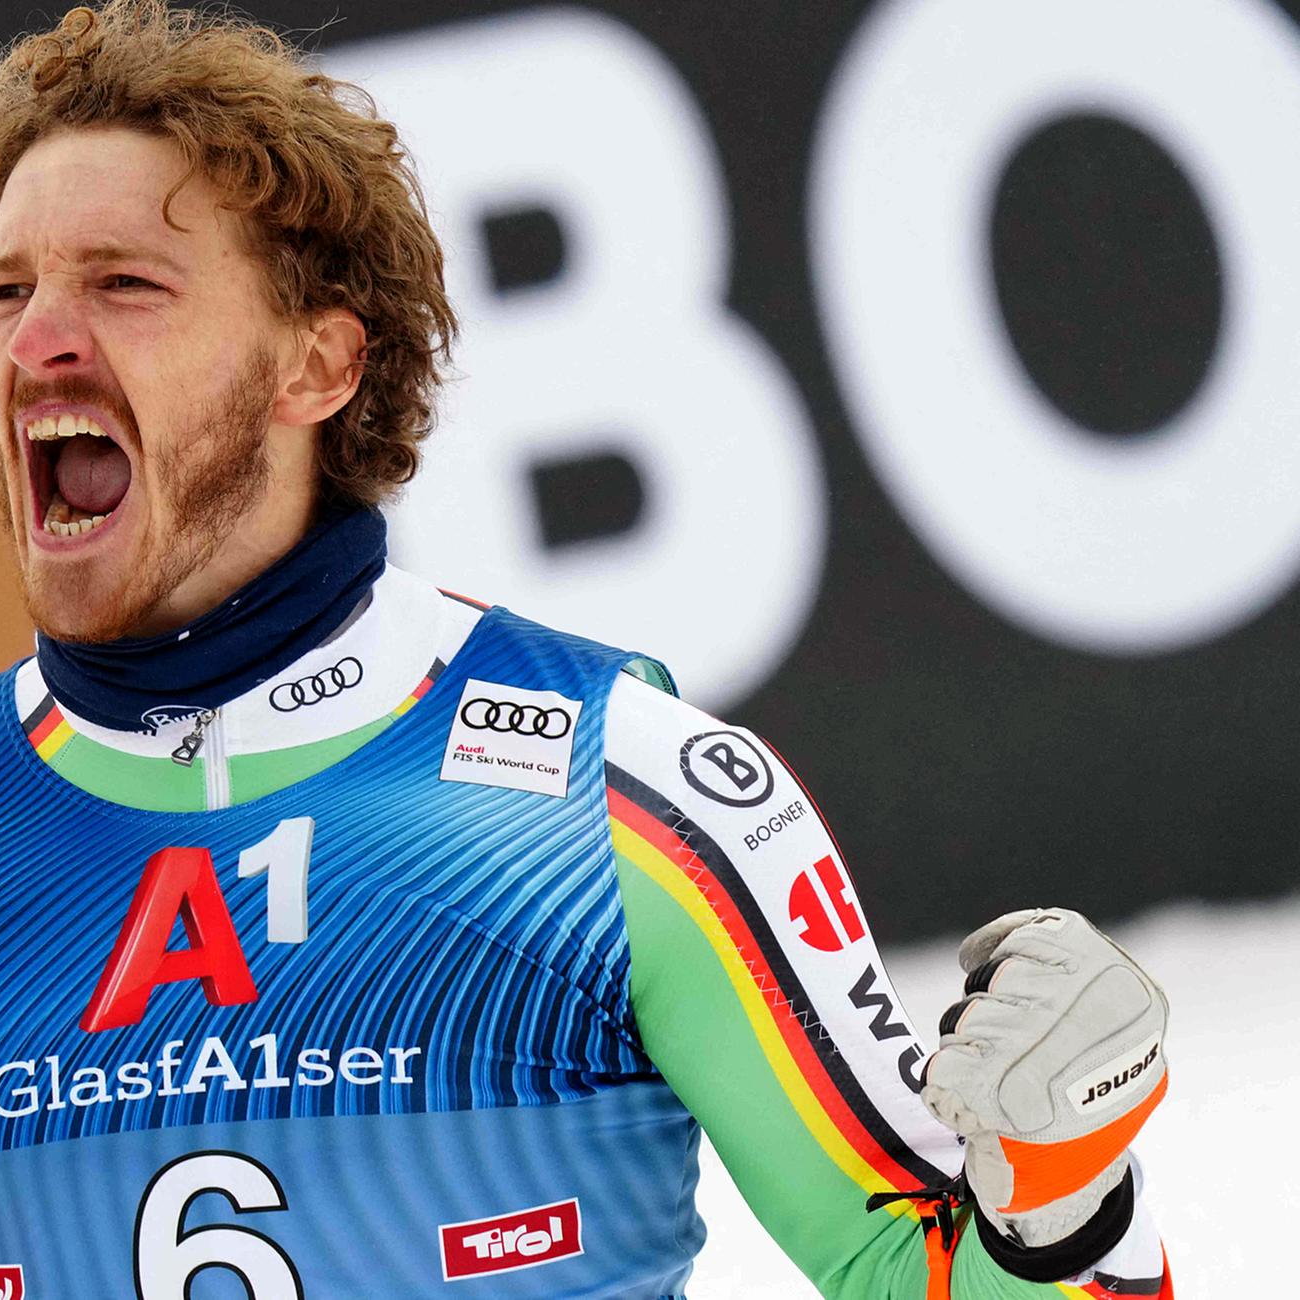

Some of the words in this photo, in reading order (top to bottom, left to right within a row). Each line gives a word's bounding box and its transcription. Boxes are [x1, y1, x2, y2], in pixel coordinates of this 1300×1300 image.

[453, 753, 473, 762] FIS
[476, 755, 494, 765] Ski
[497, 757, 534, 770] World
[536, 764, 560, 775] Cup
[455, 744, 485, 754] Audi
[743, 800, 807, 851] BOGNER
[78, 815, 316, 1034] A1
[132, 1149, 306, 1300] 6
[462, 1216, 564, 1259] Tirol
